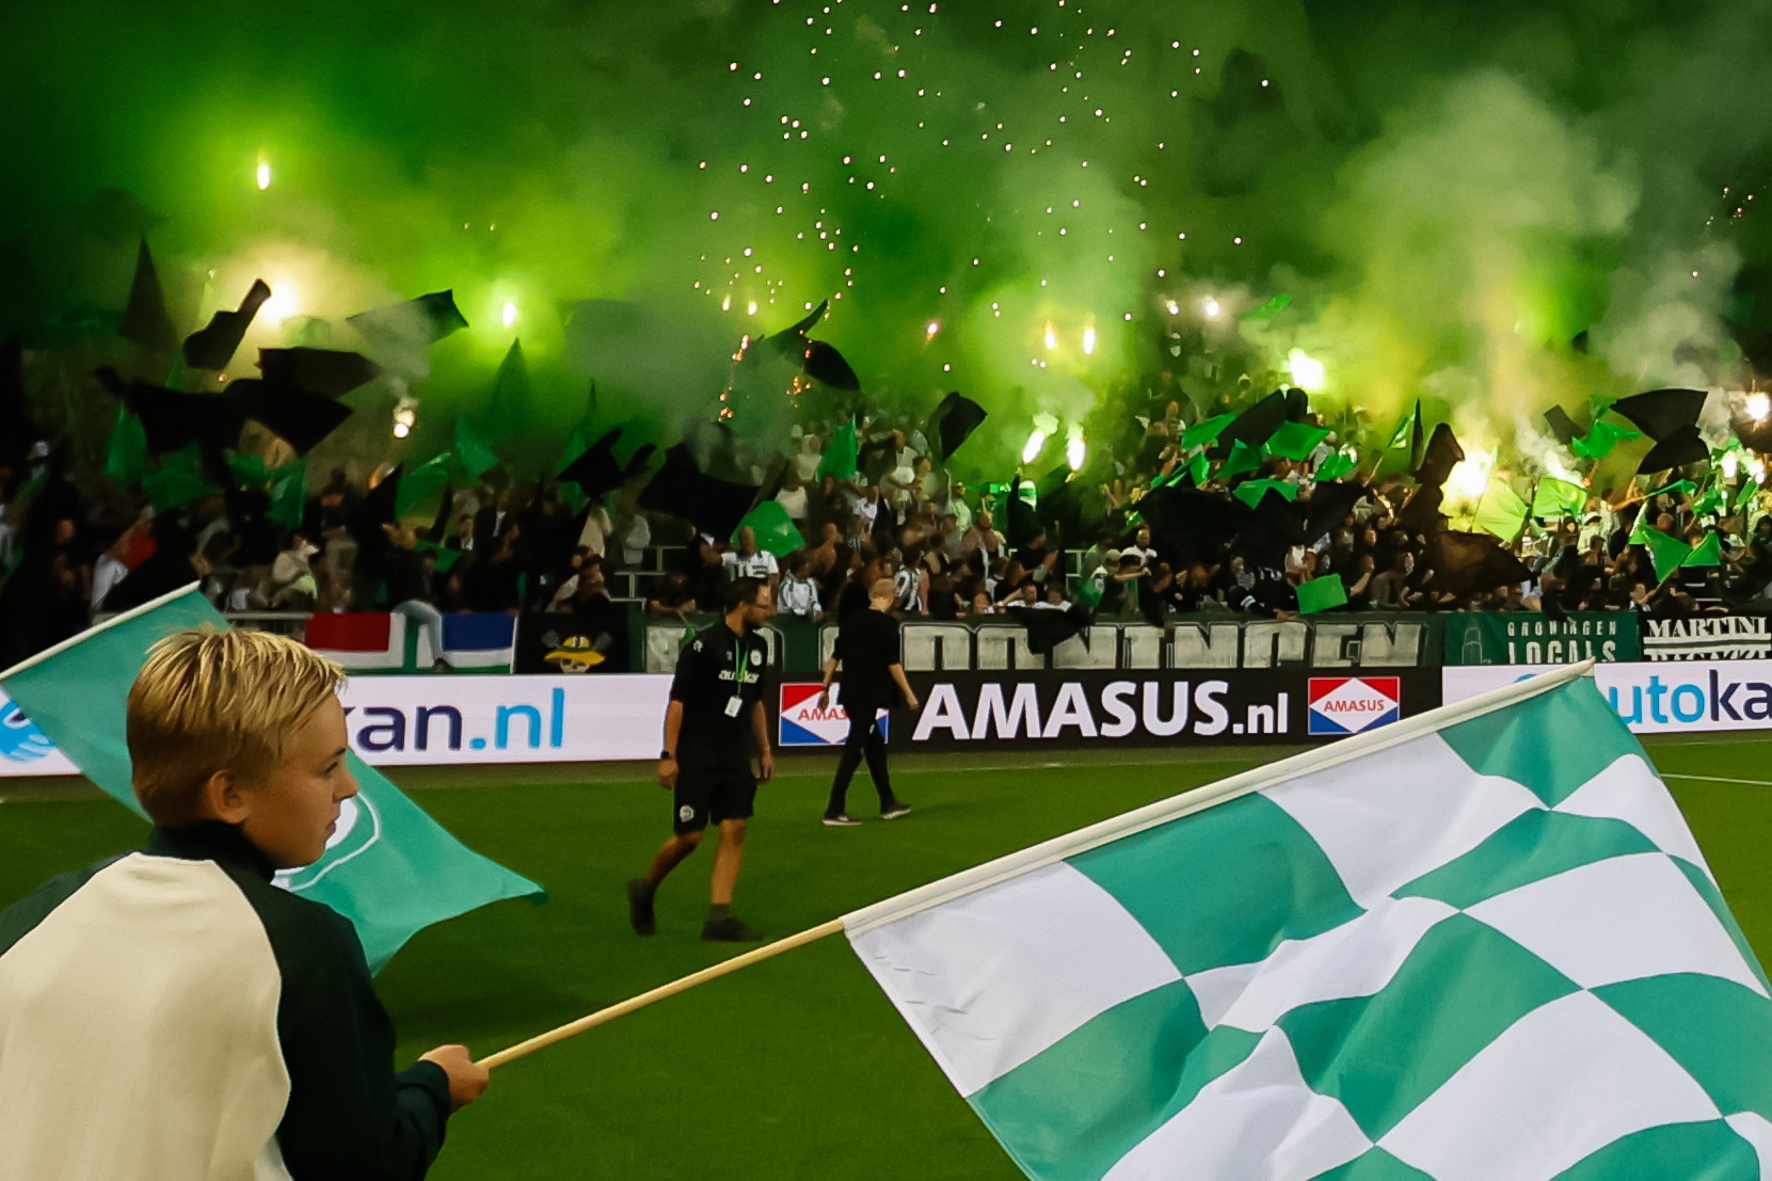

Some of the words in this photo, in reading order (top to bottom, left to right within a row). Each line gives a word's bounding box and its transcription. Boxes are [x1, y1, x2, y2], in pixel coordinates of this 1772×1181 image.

[1507, 621, 1616, 636] GRONINGEN
[1647, 616, 1767, 638] MARTINI
[912, 680, 1288, 741] AMASUS.nl
[1323, 699, 1385, 713] AMASUS
